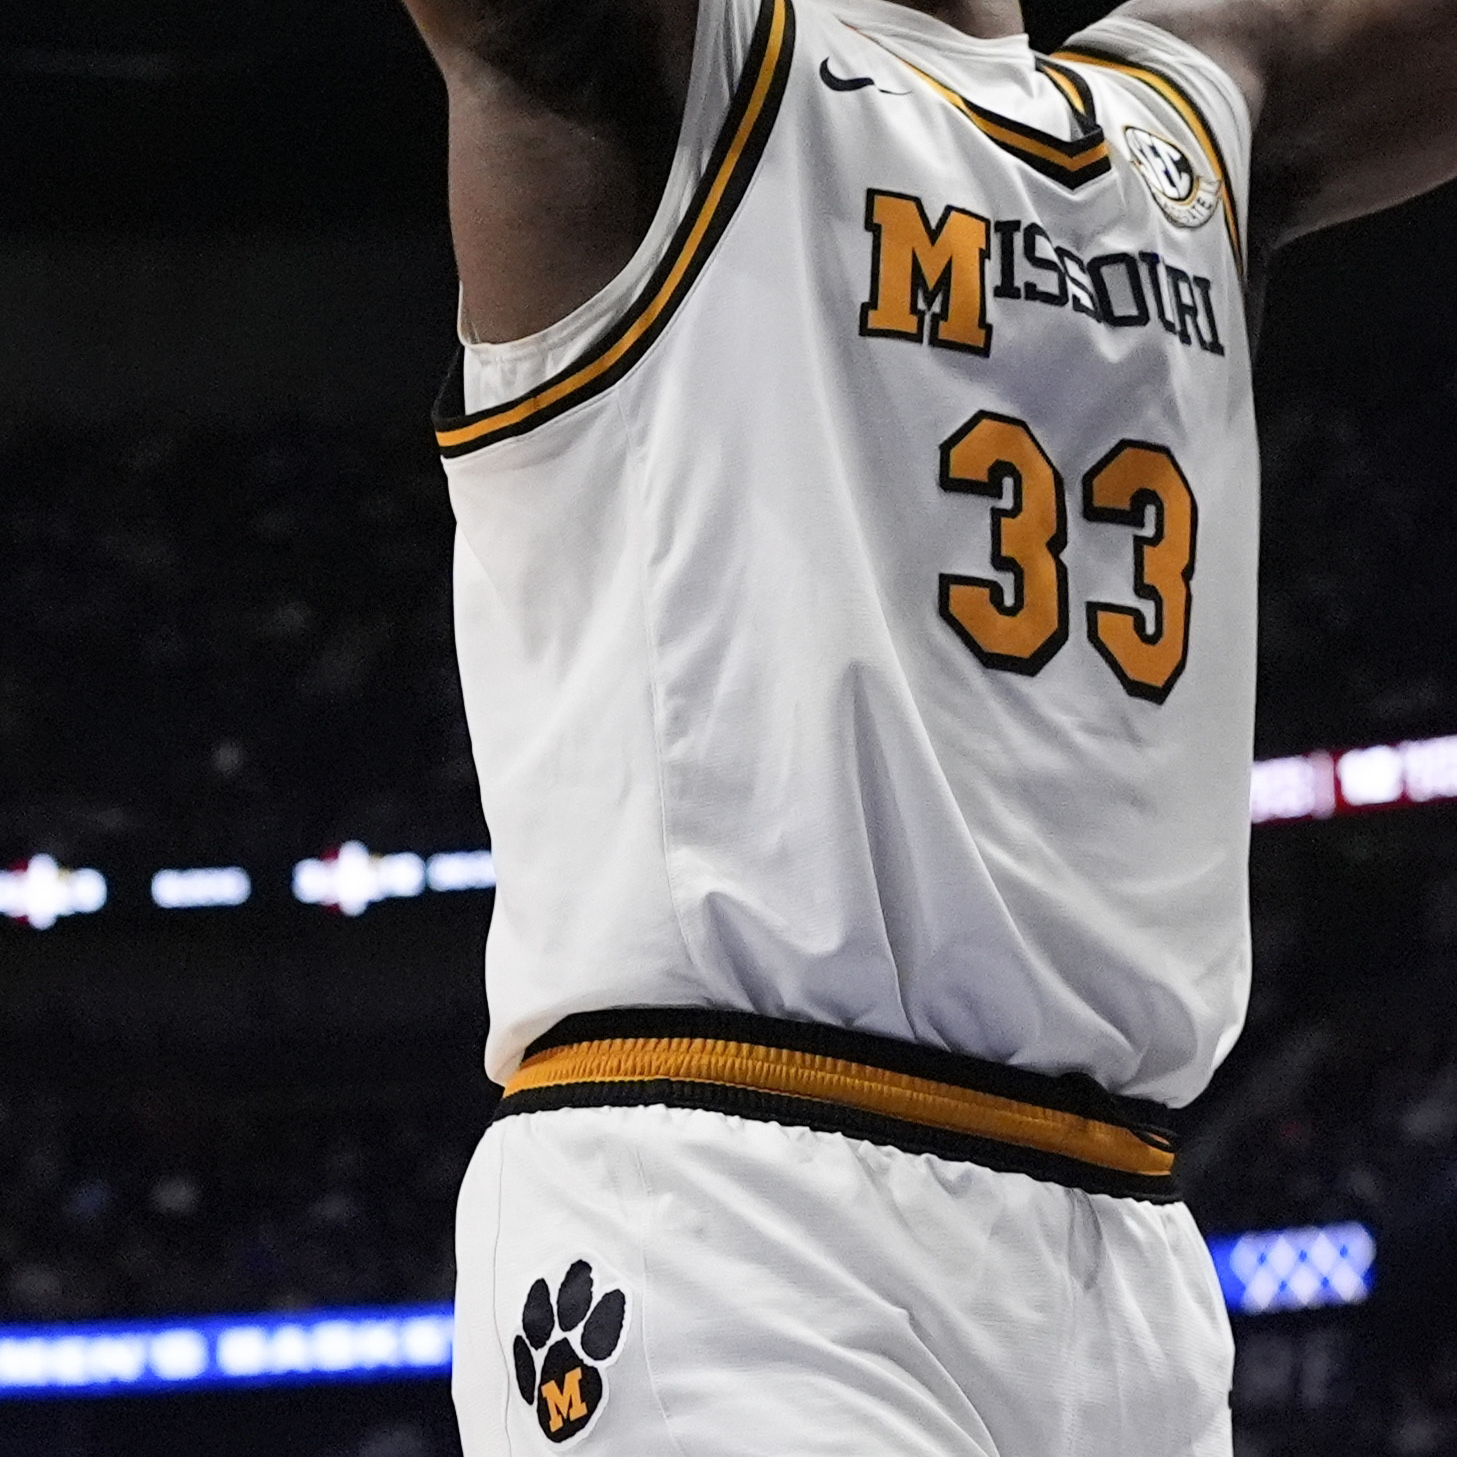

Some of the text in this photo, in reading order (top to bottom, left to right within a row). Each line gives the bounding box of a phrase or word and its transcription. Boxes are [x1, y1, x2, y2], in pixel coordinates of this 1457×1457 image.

[859, 187, 1226, 358] MISSOURI
[938, 409, 1199, 706] 33
[540, 1366, 588, 1433] M
